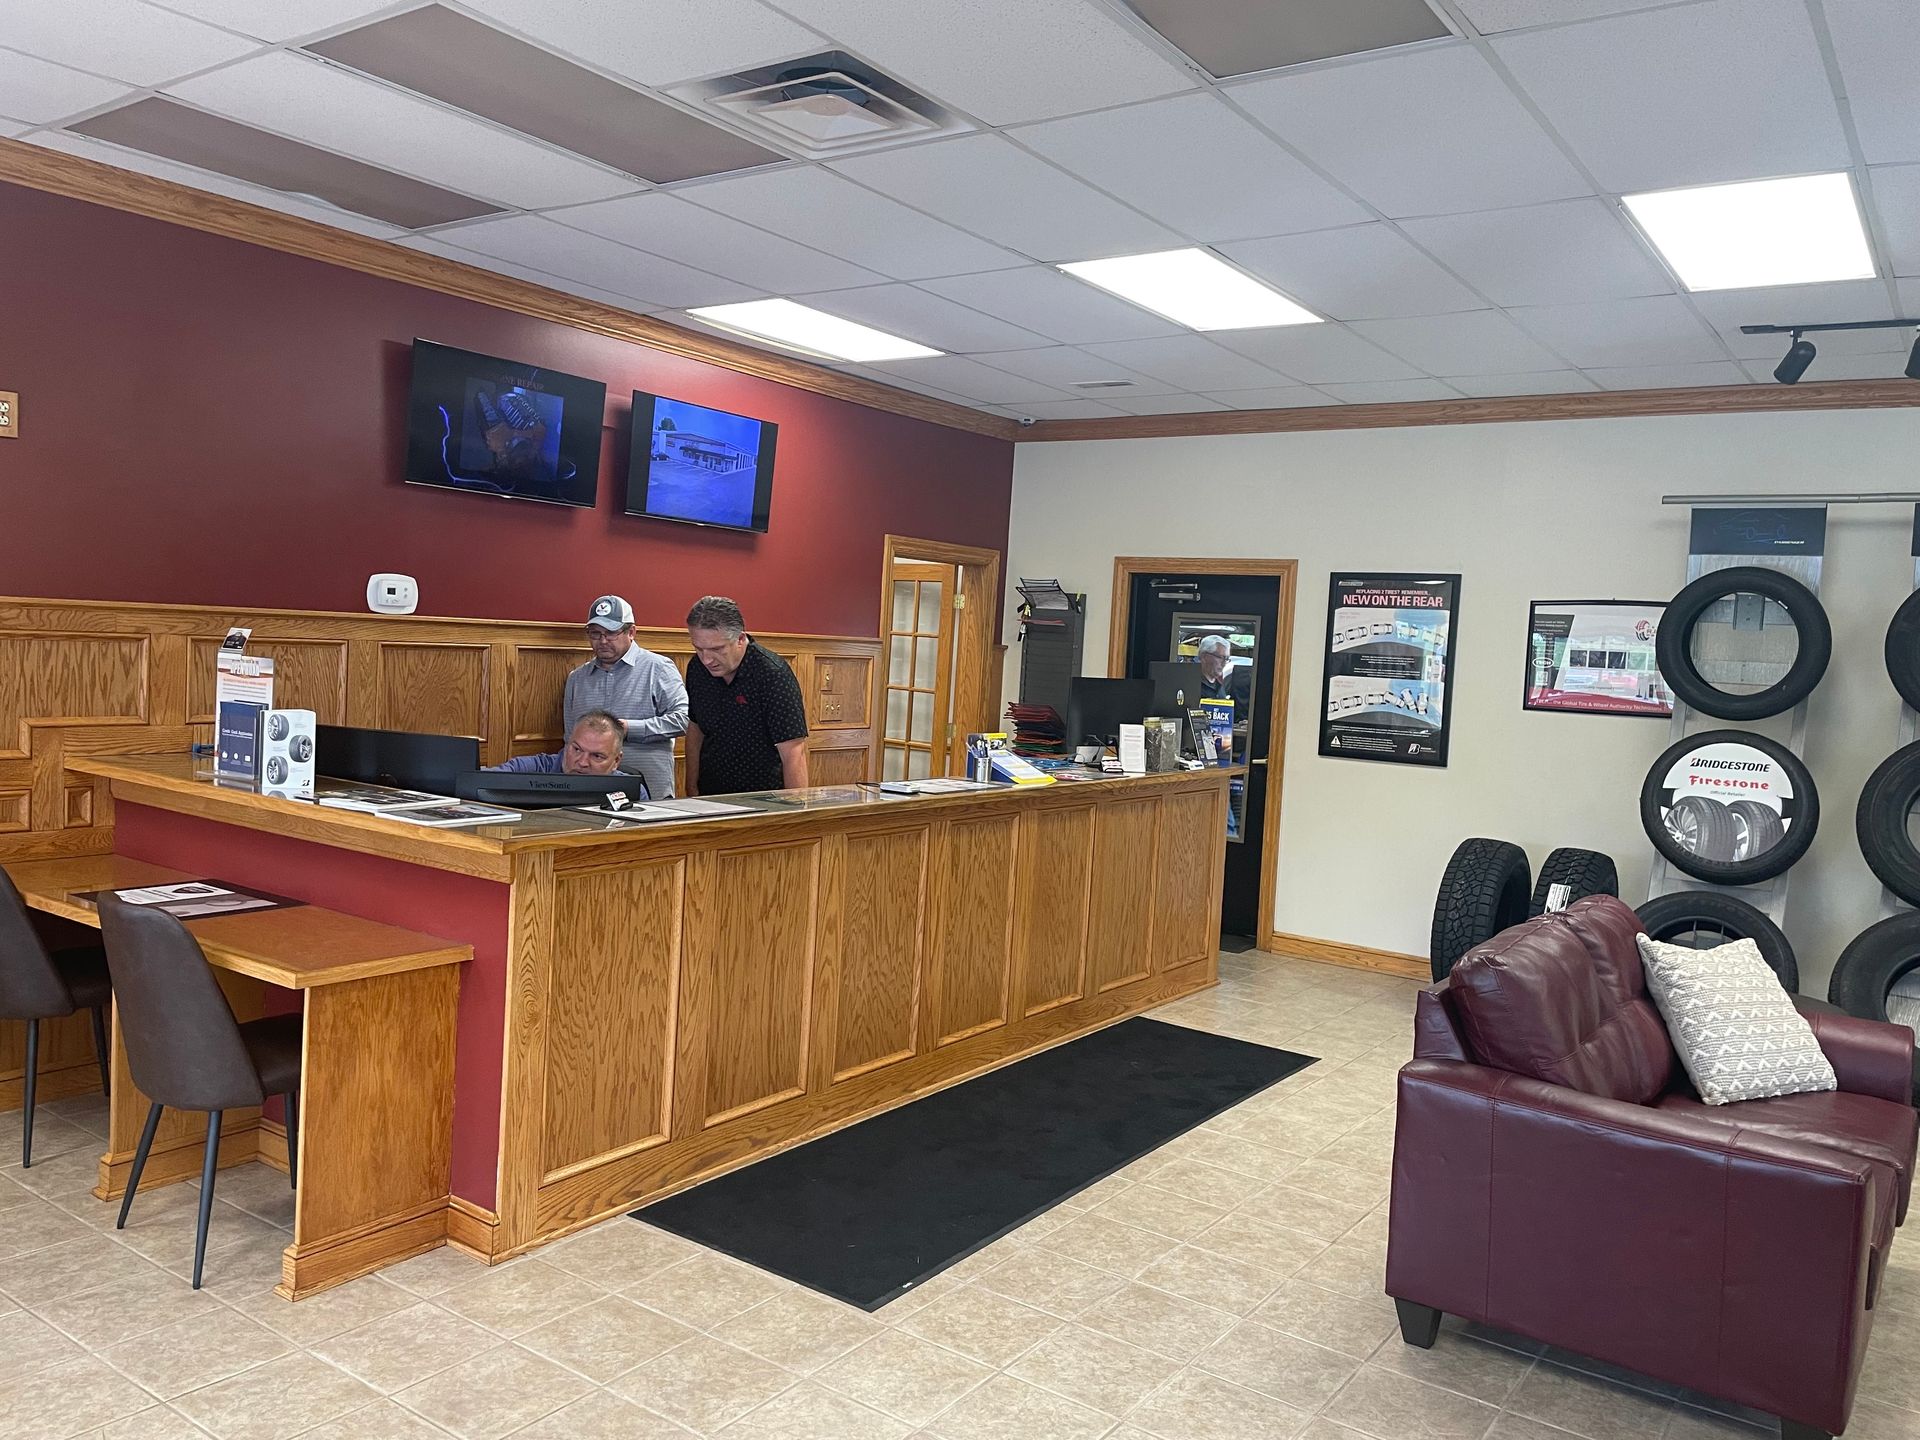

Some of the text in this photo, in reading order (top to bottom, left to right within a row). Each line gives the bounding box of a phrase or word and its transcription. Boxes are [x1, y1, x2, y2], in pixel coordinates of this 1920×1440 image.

[1343, 594, 1443, 608] NEW ON THE REAR
[1212, 712, 1230, 720] BACK
[1690, 758, 1771, 772] BRIDGESTONE
[529, 780, 571, 790] ViewSonic
[1688, 775, 1770, 790] Firestone
